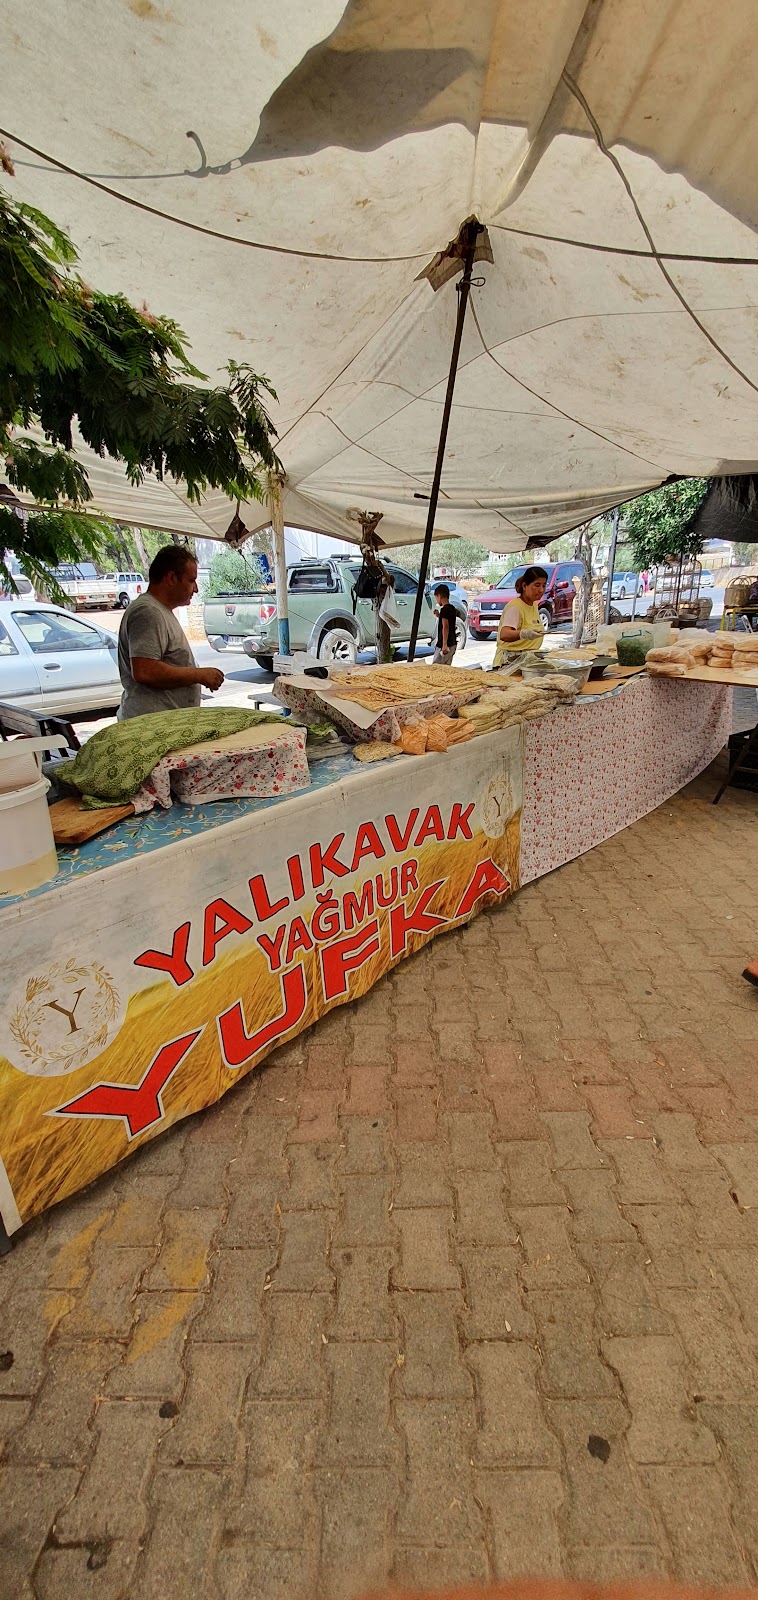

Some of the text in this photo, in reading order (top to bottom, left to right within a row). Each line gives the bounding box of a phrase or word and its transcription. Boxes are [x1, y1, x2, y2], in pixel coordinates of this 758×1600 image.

[492, 793, 505, 818] Y
[133, 802, 476, 986] YALIKAVAK
[257, 859, 418, 972] YAĞMUR
[44, 987, 87, 1035] Y
[46, 857, 511, 1142] YUFKA
